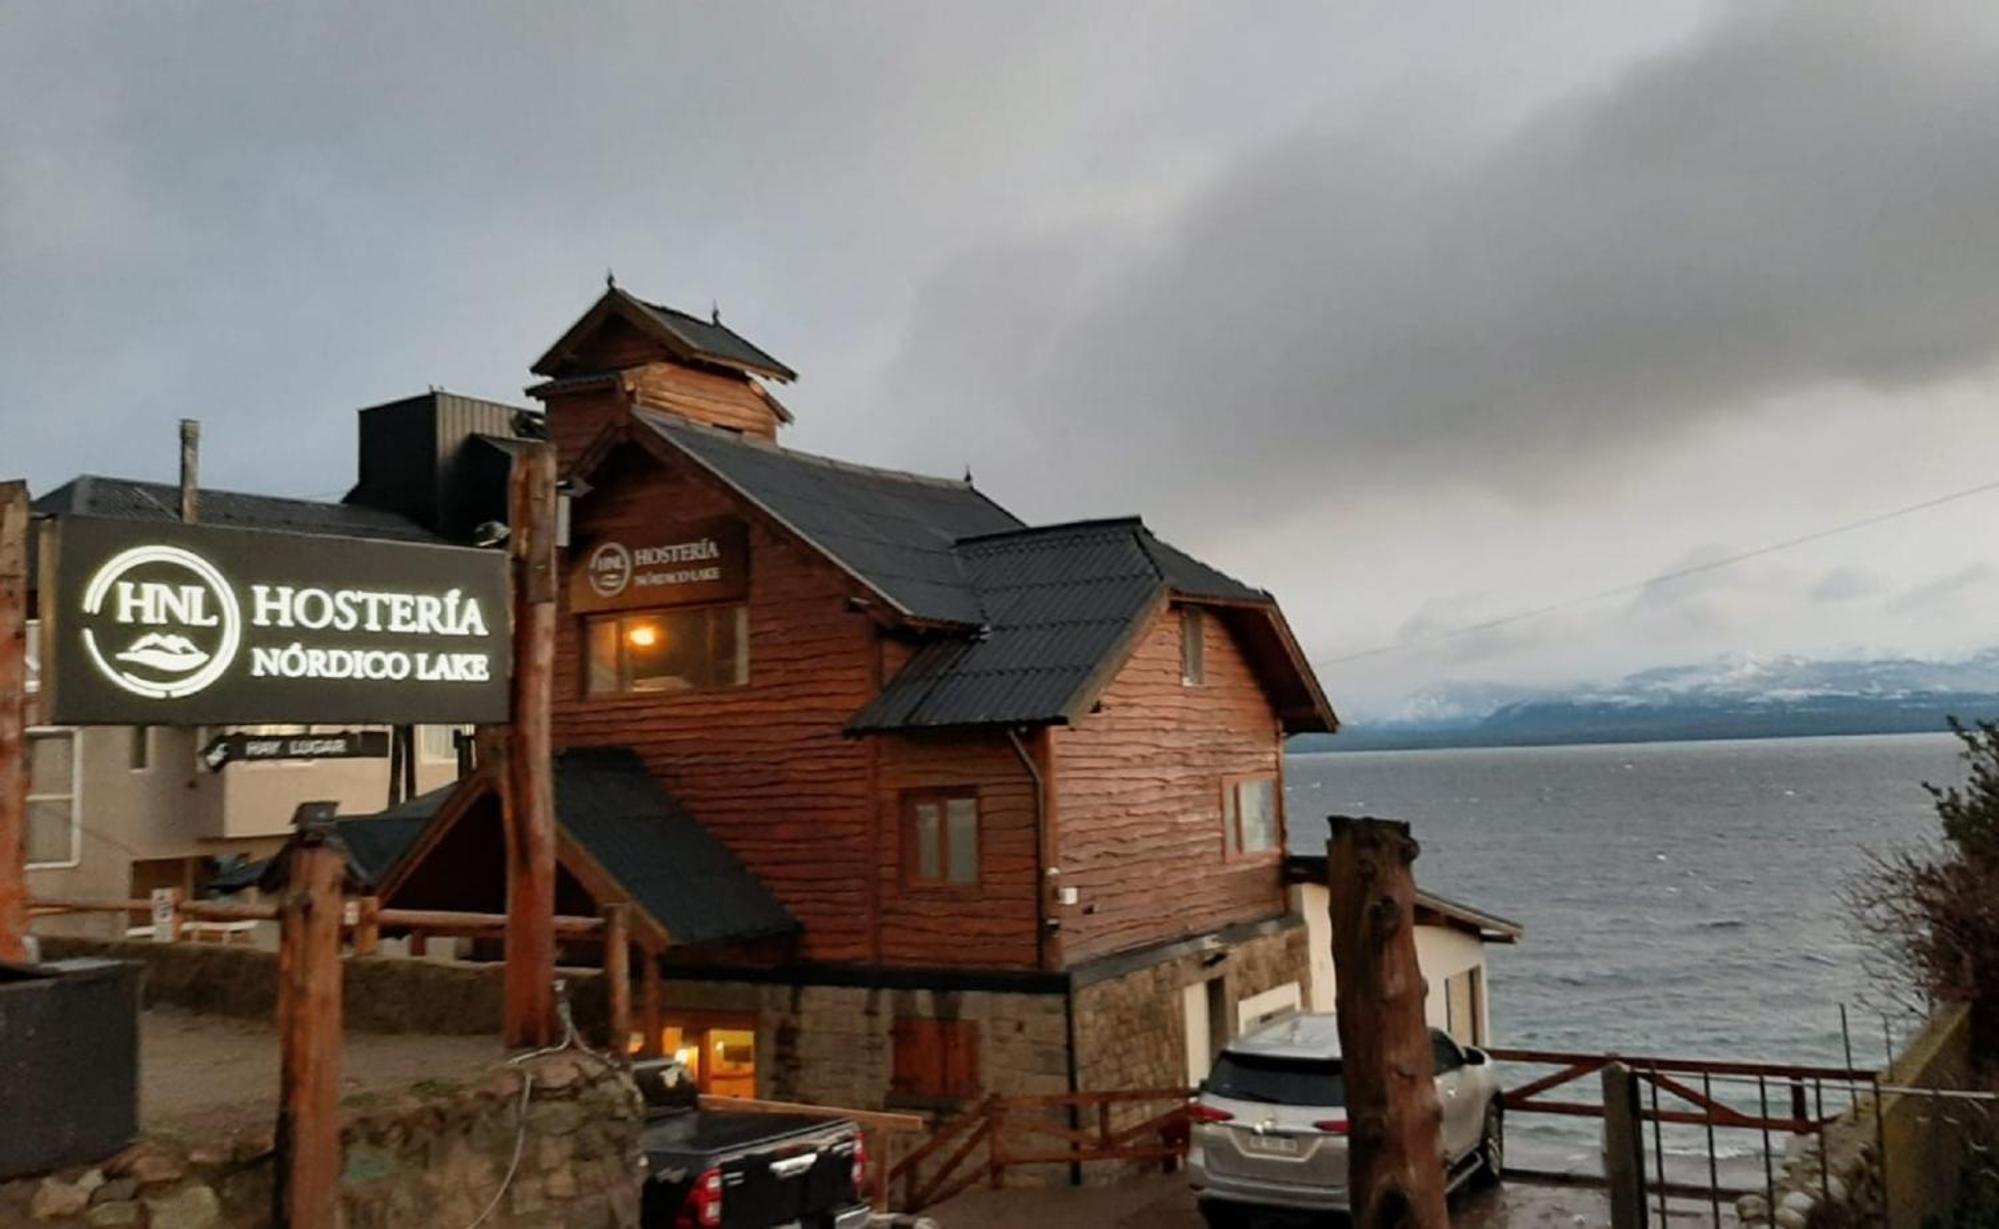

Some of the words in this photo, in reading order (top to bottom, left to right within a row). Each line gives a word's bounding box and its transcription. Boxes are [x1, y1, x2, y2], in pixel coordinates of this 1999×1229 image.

[634, 538, 719, 566] HOSTERÍA
[116, 581, 219, 626] HNL
[251, 584, 489, 636] HOSTERÍA
[251, 642, 411, 680] NÓRDICO
[415, 652, 490, 681] LAKE
